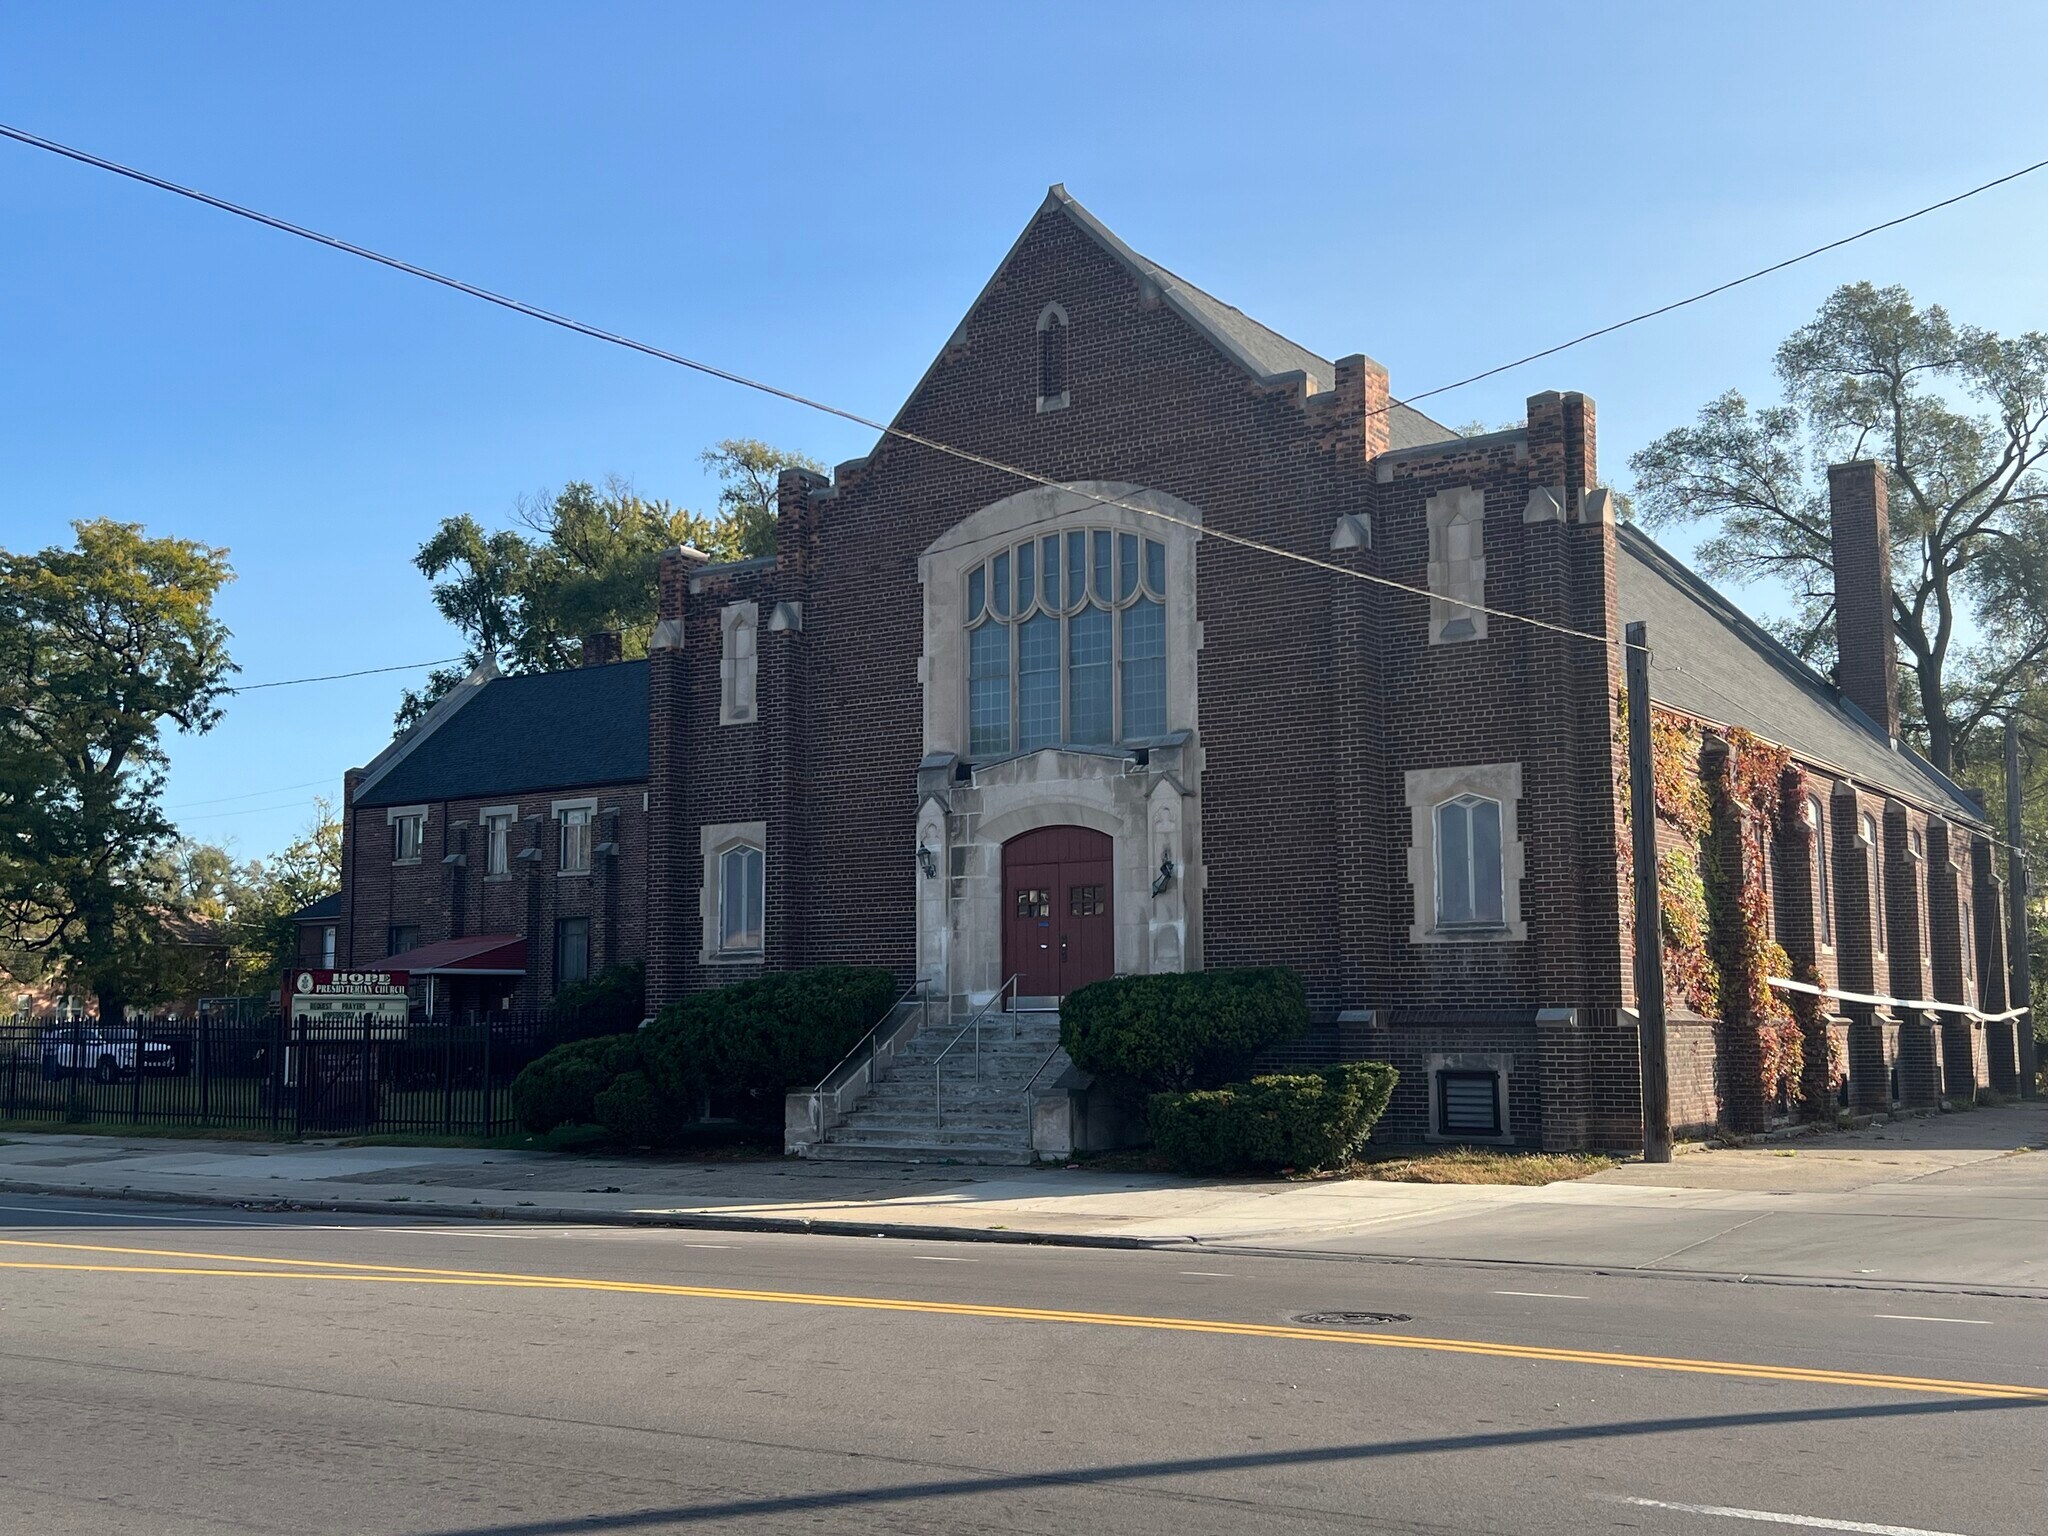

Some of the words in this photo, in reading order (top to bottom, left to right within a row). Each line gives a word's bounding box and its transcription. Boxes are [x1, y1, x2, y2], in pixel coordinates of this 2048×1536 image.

[332, 973, 391, 985] HOPE
[316, 984, 372, 994] PRESBYTERIAN
[375, 985, 405, 994] CHURCH
